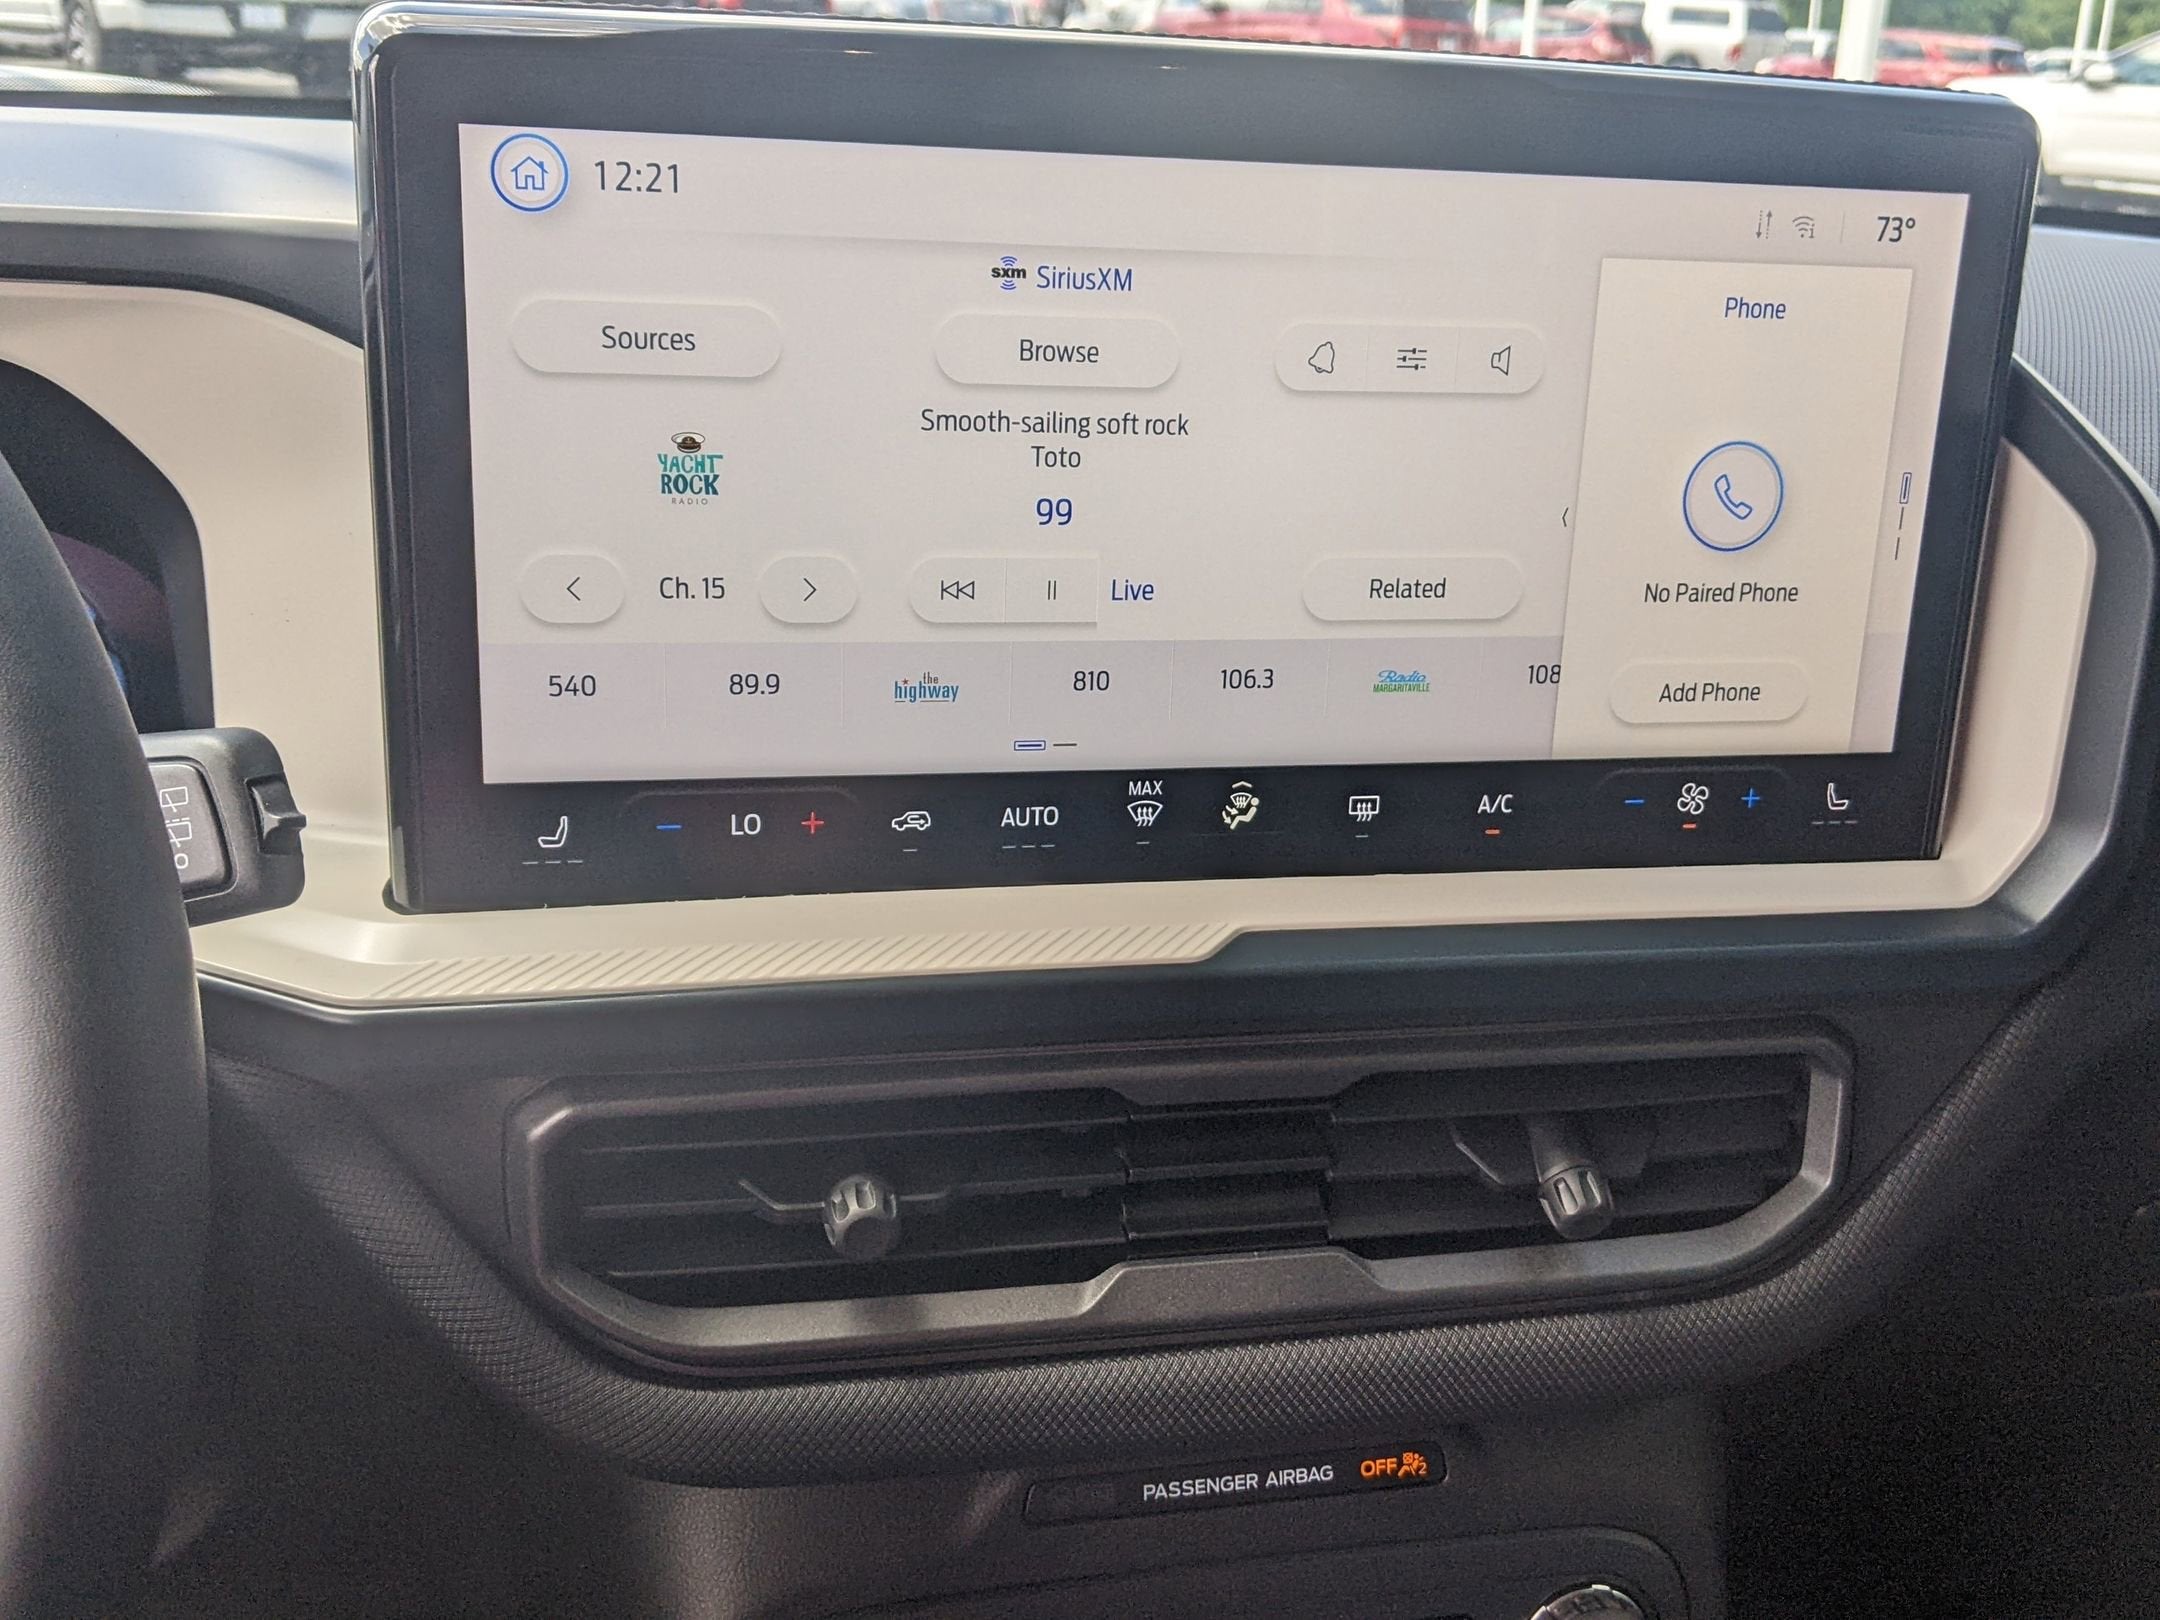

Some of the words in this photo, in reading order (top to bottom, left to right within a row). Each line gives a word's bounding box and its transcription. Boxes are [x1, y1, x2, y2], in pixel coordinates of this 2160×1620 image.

[594, 160, 680, 194] 12:21
[1877, 215, 1917, 243] 73°
[1036, 265, 1133, 292] SiriusXM
[1724, 296, 1787, 320] Phone
[600, 325, 697, 353] Sources
[1018, 338, 1100, 365] Browse
[920, 408, 1091, 439] Smooth-sailing
[1095, 411, 1140, 437] soft
[1144, 412, 1190, 437] rock
[657, 453, 724, 474] YACHT
[1030, 445, 1082, 469] Toto
[660, 473, 720, 496] ROCK
[671, 497, 709, 505] RADIO
[1036, 497, 1073, 526] 99
[659, 575, 696, 600] Ch.
[701, 576, 726, 600] 15
[1111, 578, 1155, 601] Live
[1368, 576, 1447, 600] Related
[1644, 582, 1671, 604] No
[1675, 581, 1736, 603] Paired
[1738, 581, 1800, 603] Phone
[548, 674, 597, 698] 540
[728, 673, 781, 697] 89.9
[922, 672, 939, 685] the
[1073, 670, 1111, 692] 810
[1220, 668, 1275, 691] 106.3
[1373, 682, 1430, 693] MARGARITAVILLE
[894, 680, 959, 703] highway
[1657, 682, 1697, 703] Add
[1701, 681, 1761, 703] Phone
[1128, 779, 1164, 796] MAX
[1476, 792, 1514, 815] A/C
[729, 813, 763, 836] LO
[1000, 805, 1060, 828] AUTO
[1142, 1472, 1259, 1502] PASSENGER
[1264, 1464, 1335, 1489] AIRBAG
[1359, 1457, 1398, 1478] OFF
